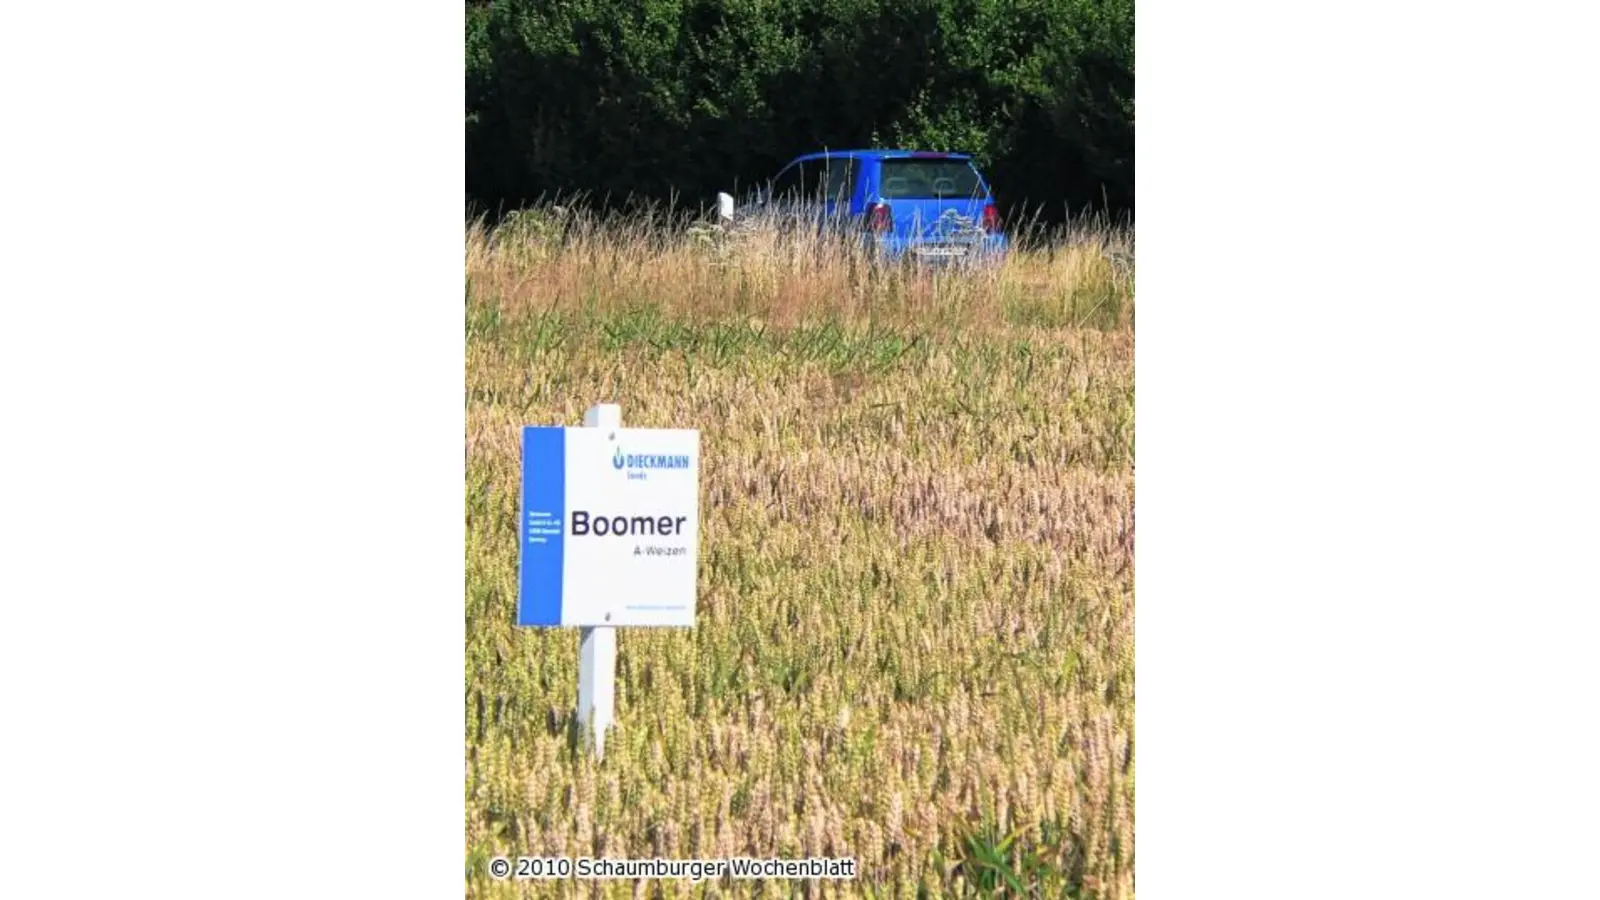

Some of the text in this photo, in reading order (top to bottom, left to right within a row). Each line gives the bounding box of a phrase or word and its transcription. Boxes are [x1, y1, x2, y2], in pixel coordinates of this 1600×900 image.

[626, 454, 690, 469] DIECKMANN
[571, 510, 687, 536] Boomer
[633, 545, 687, 557] A-Weizen
